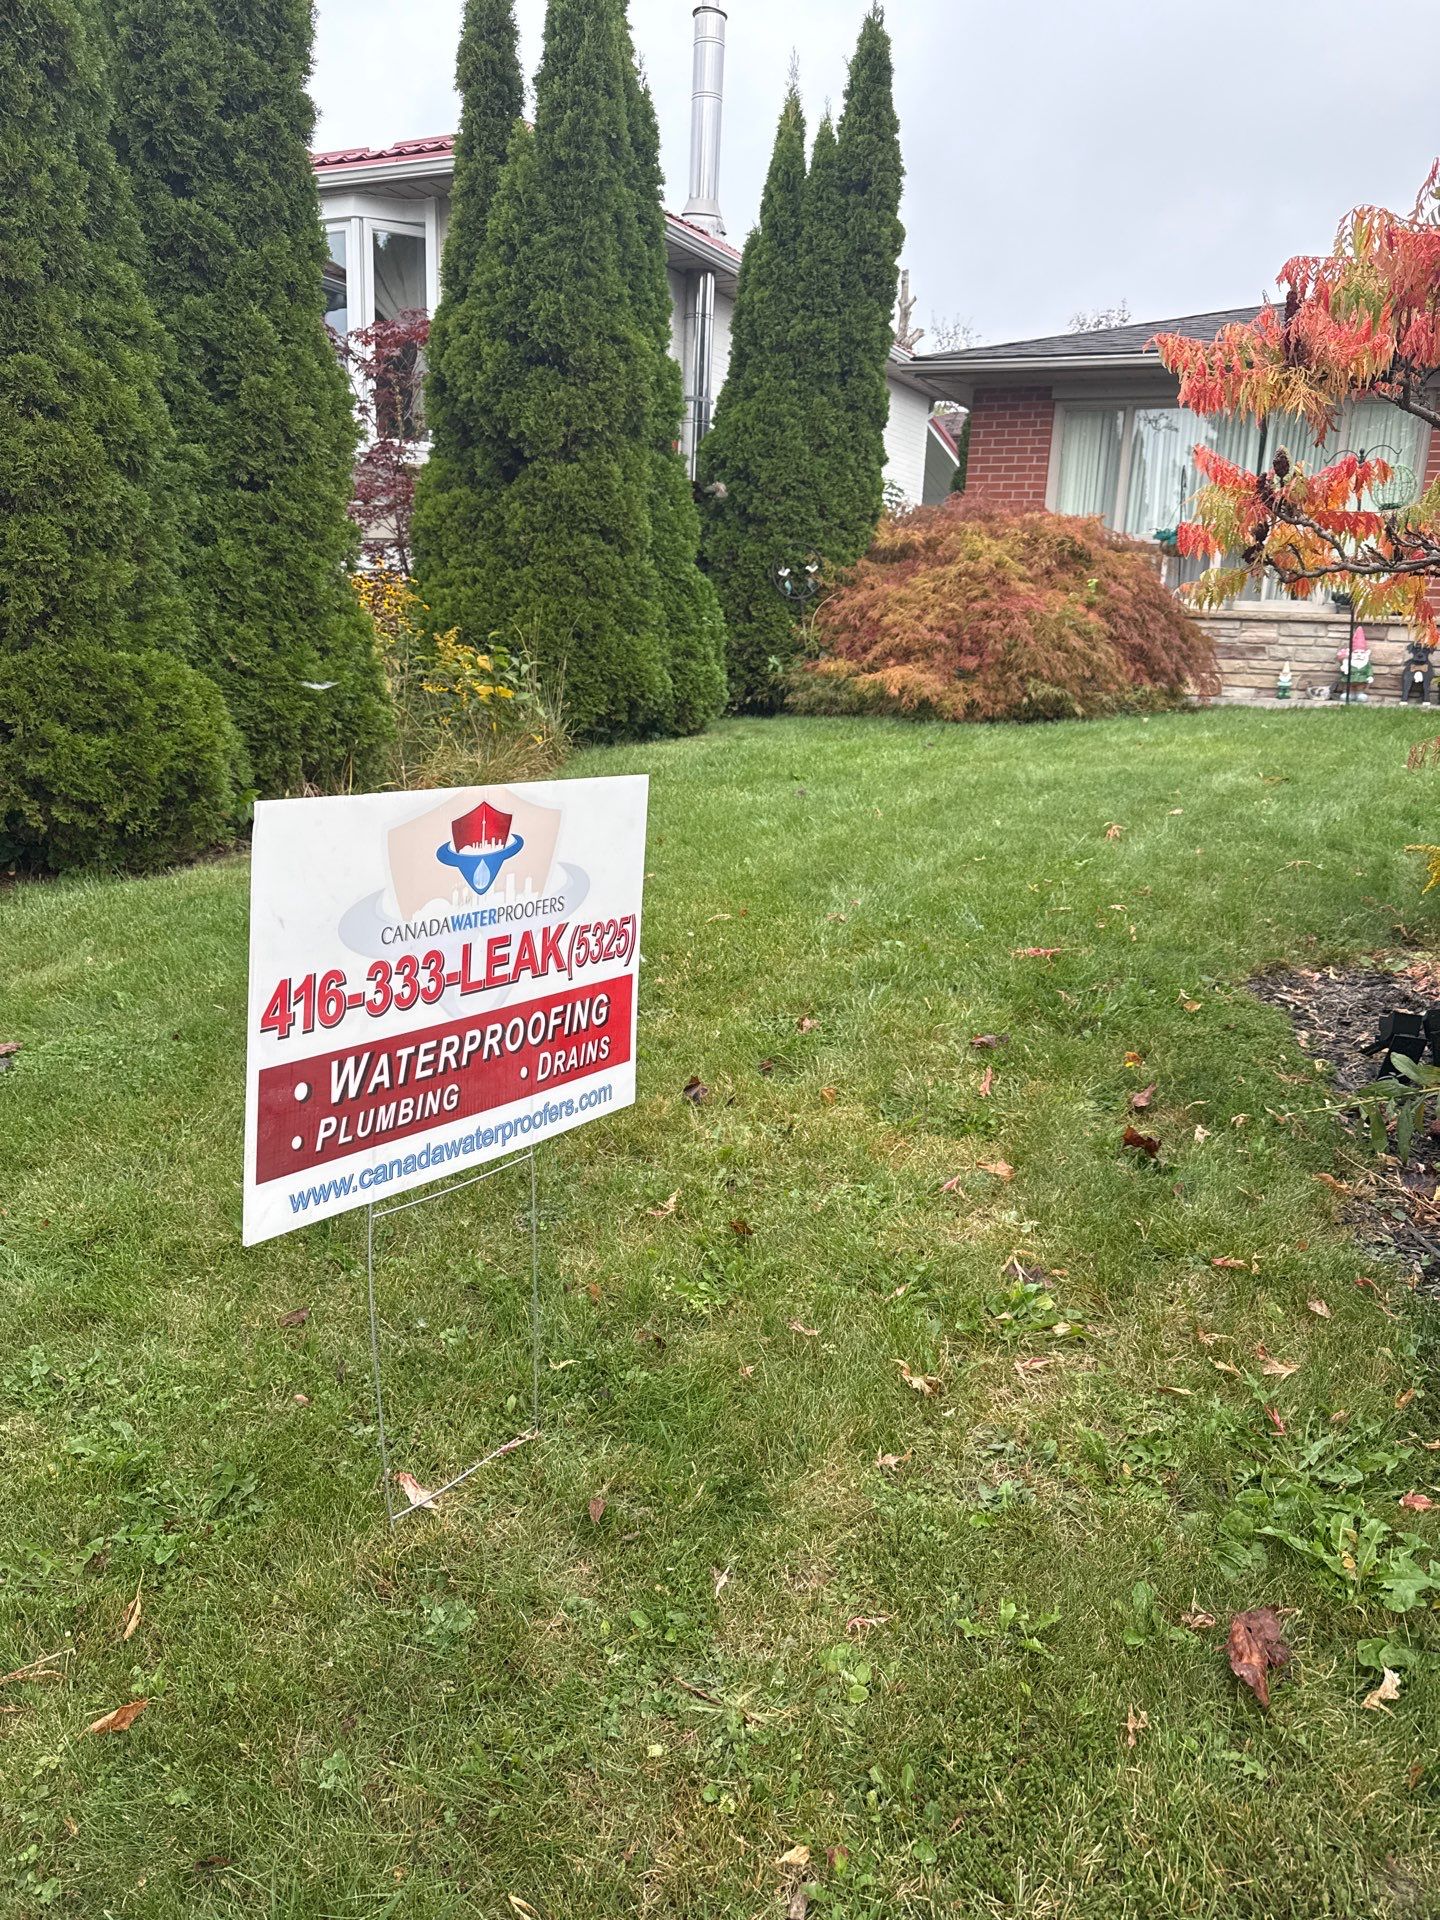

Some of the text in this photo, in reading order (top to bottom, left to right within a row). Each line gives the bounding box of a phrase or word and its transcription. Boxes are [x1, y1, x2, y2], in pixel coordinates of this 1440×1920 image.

[381, 895, 566, 946] CANADAWATERPROOFERS
[329, 992, 611, 1105] WATERPROOFING
[536, 1035, 611, 1082] DRAINS
[288, 1081, 613, 1213] www.canadawaterproofers.com
[314, 1083, 460, 1153] PLUMBING
